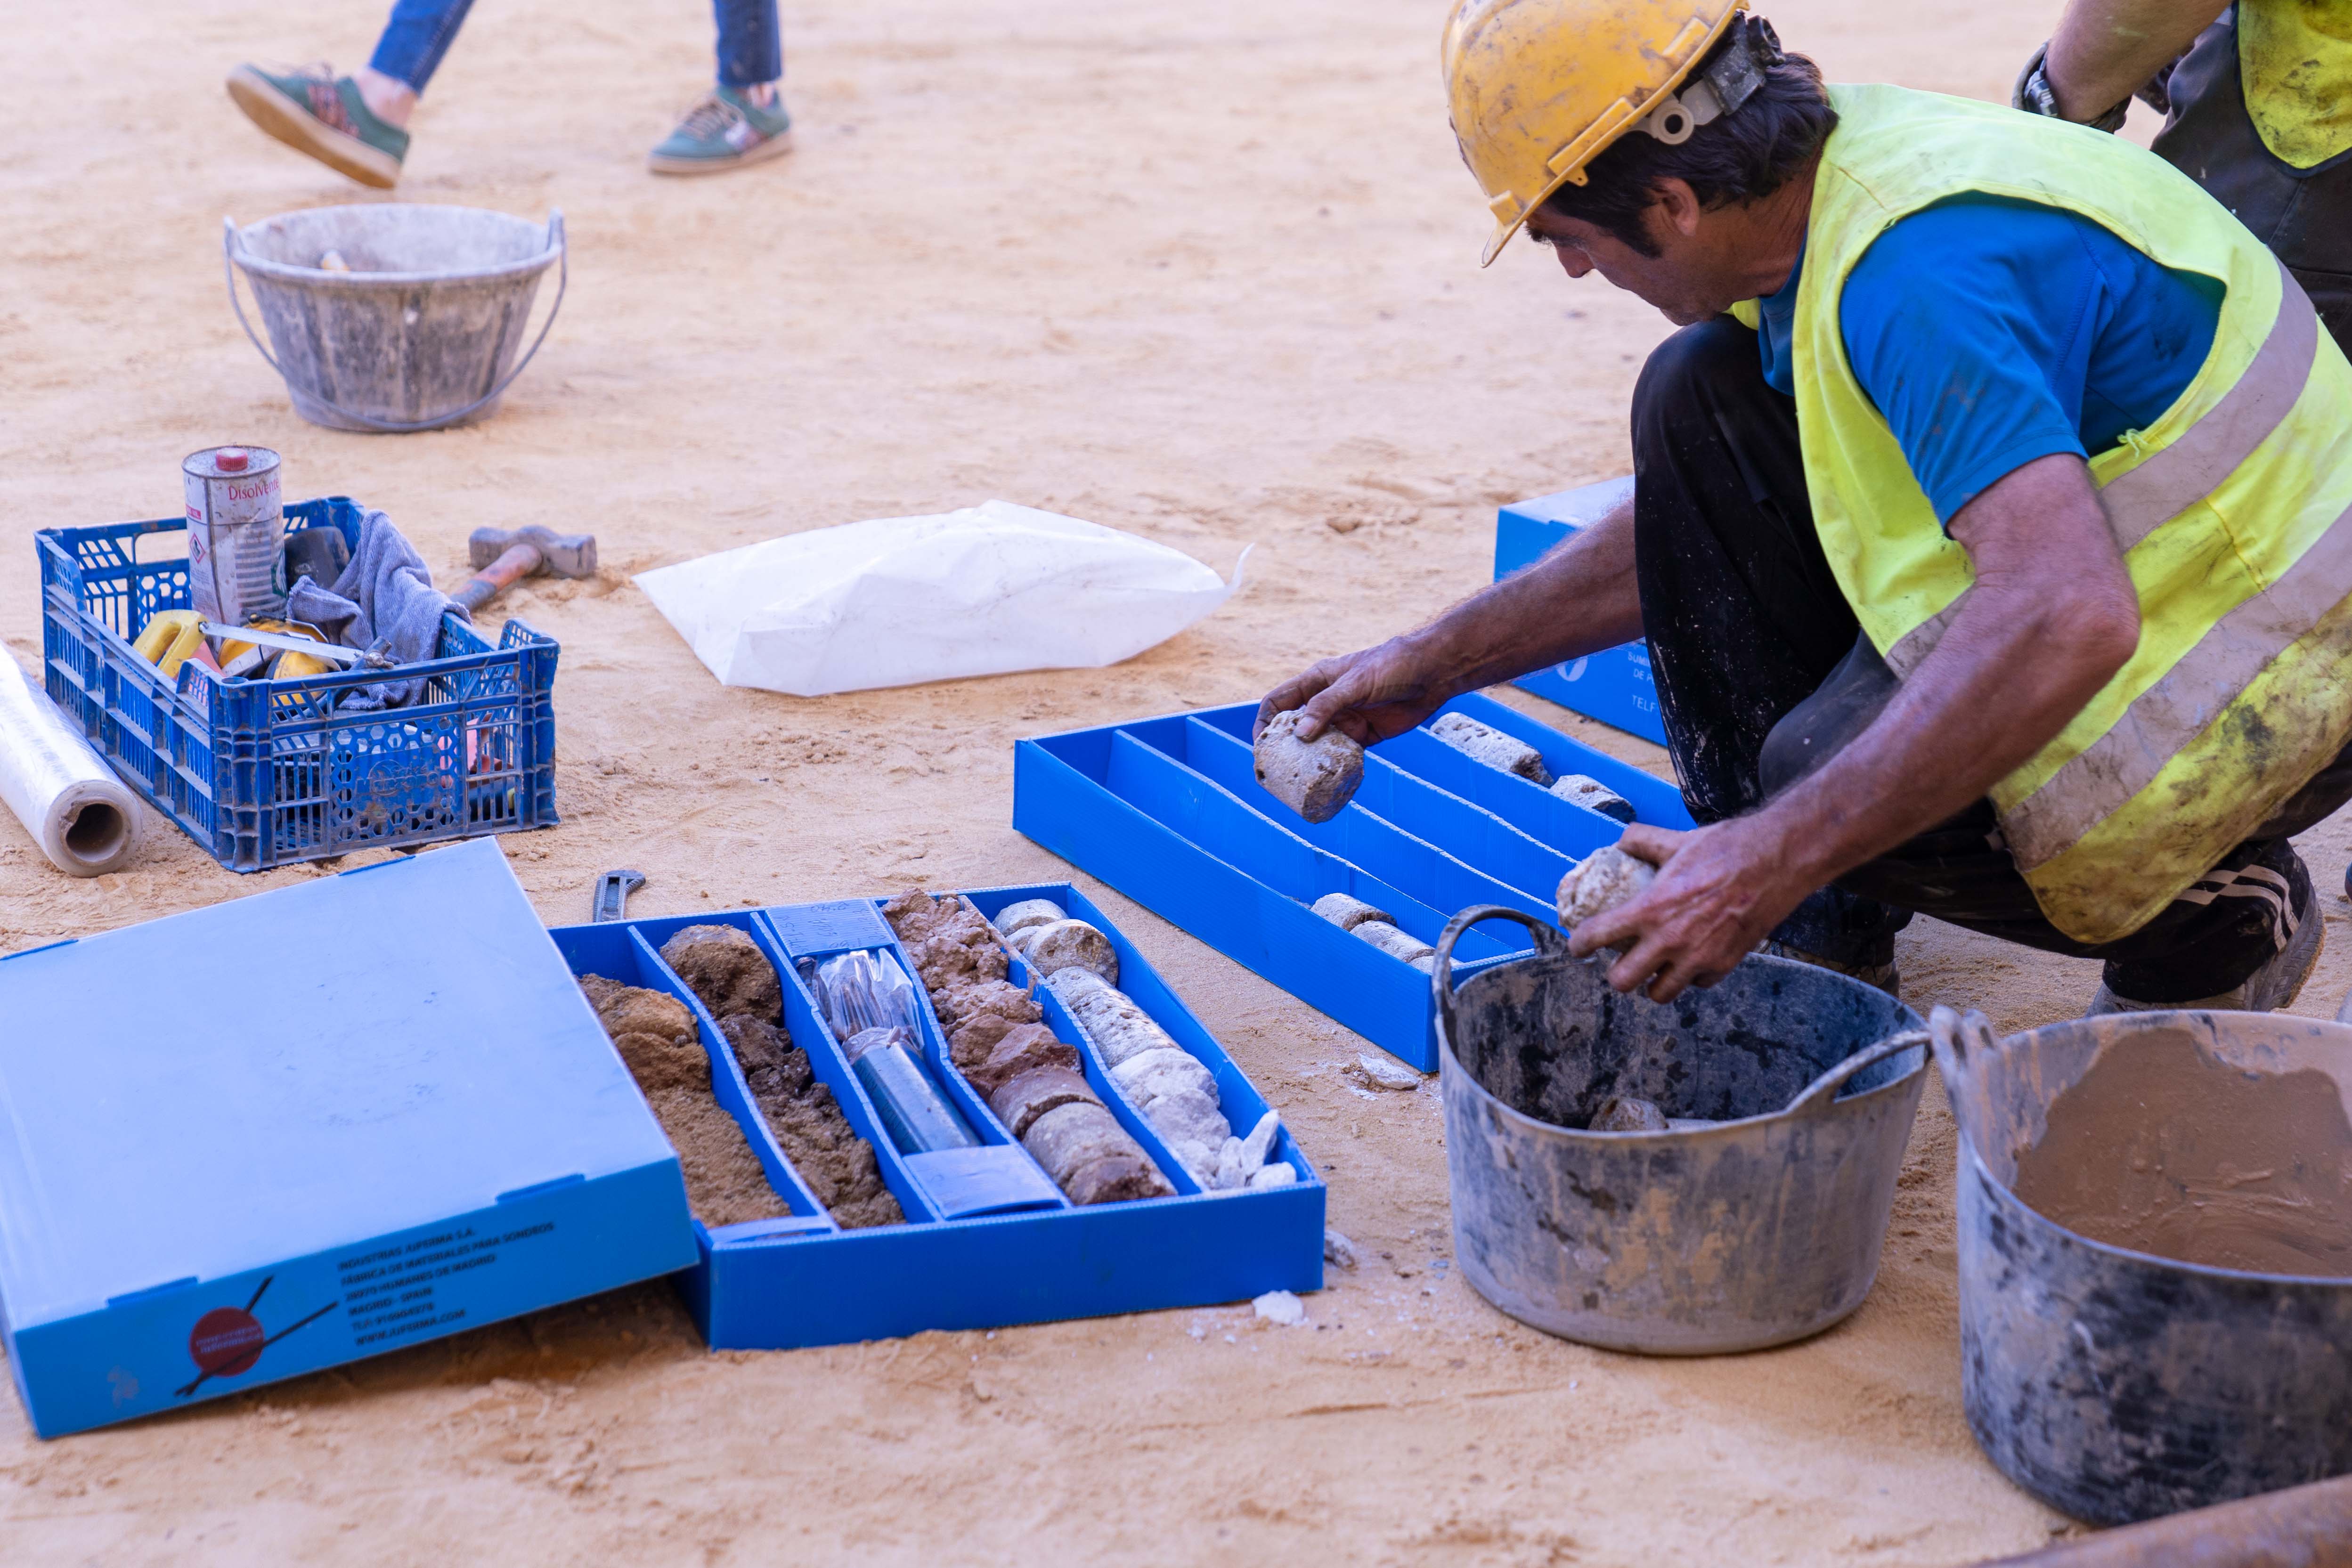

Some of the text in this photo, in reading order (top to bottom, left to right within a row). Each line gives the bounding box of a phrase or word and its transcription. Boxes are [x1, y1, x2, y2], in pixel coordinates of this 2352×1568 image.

[228, 478, 279, 500] Disolvente
[1633, 668, 1644, 680] DE
[337, 1247, 402, 1271] INDUSTRIAS
[405, 1233, 453, 1251] JUPERMA
[389, 1262, 403, 1273] DE
[405, 1245, 470, 1269] MATERIALES
[472, 1235, 500, 1251] PARA
[379, 1271, 434, 1291] HUMANES
[435, 1267, 449, 1278] DE
[452, 1253, 497, 1273] MADRID
[348, 1297, 393, 1317] MADRID
[401, 1286, 433, 1302] SPAIN
